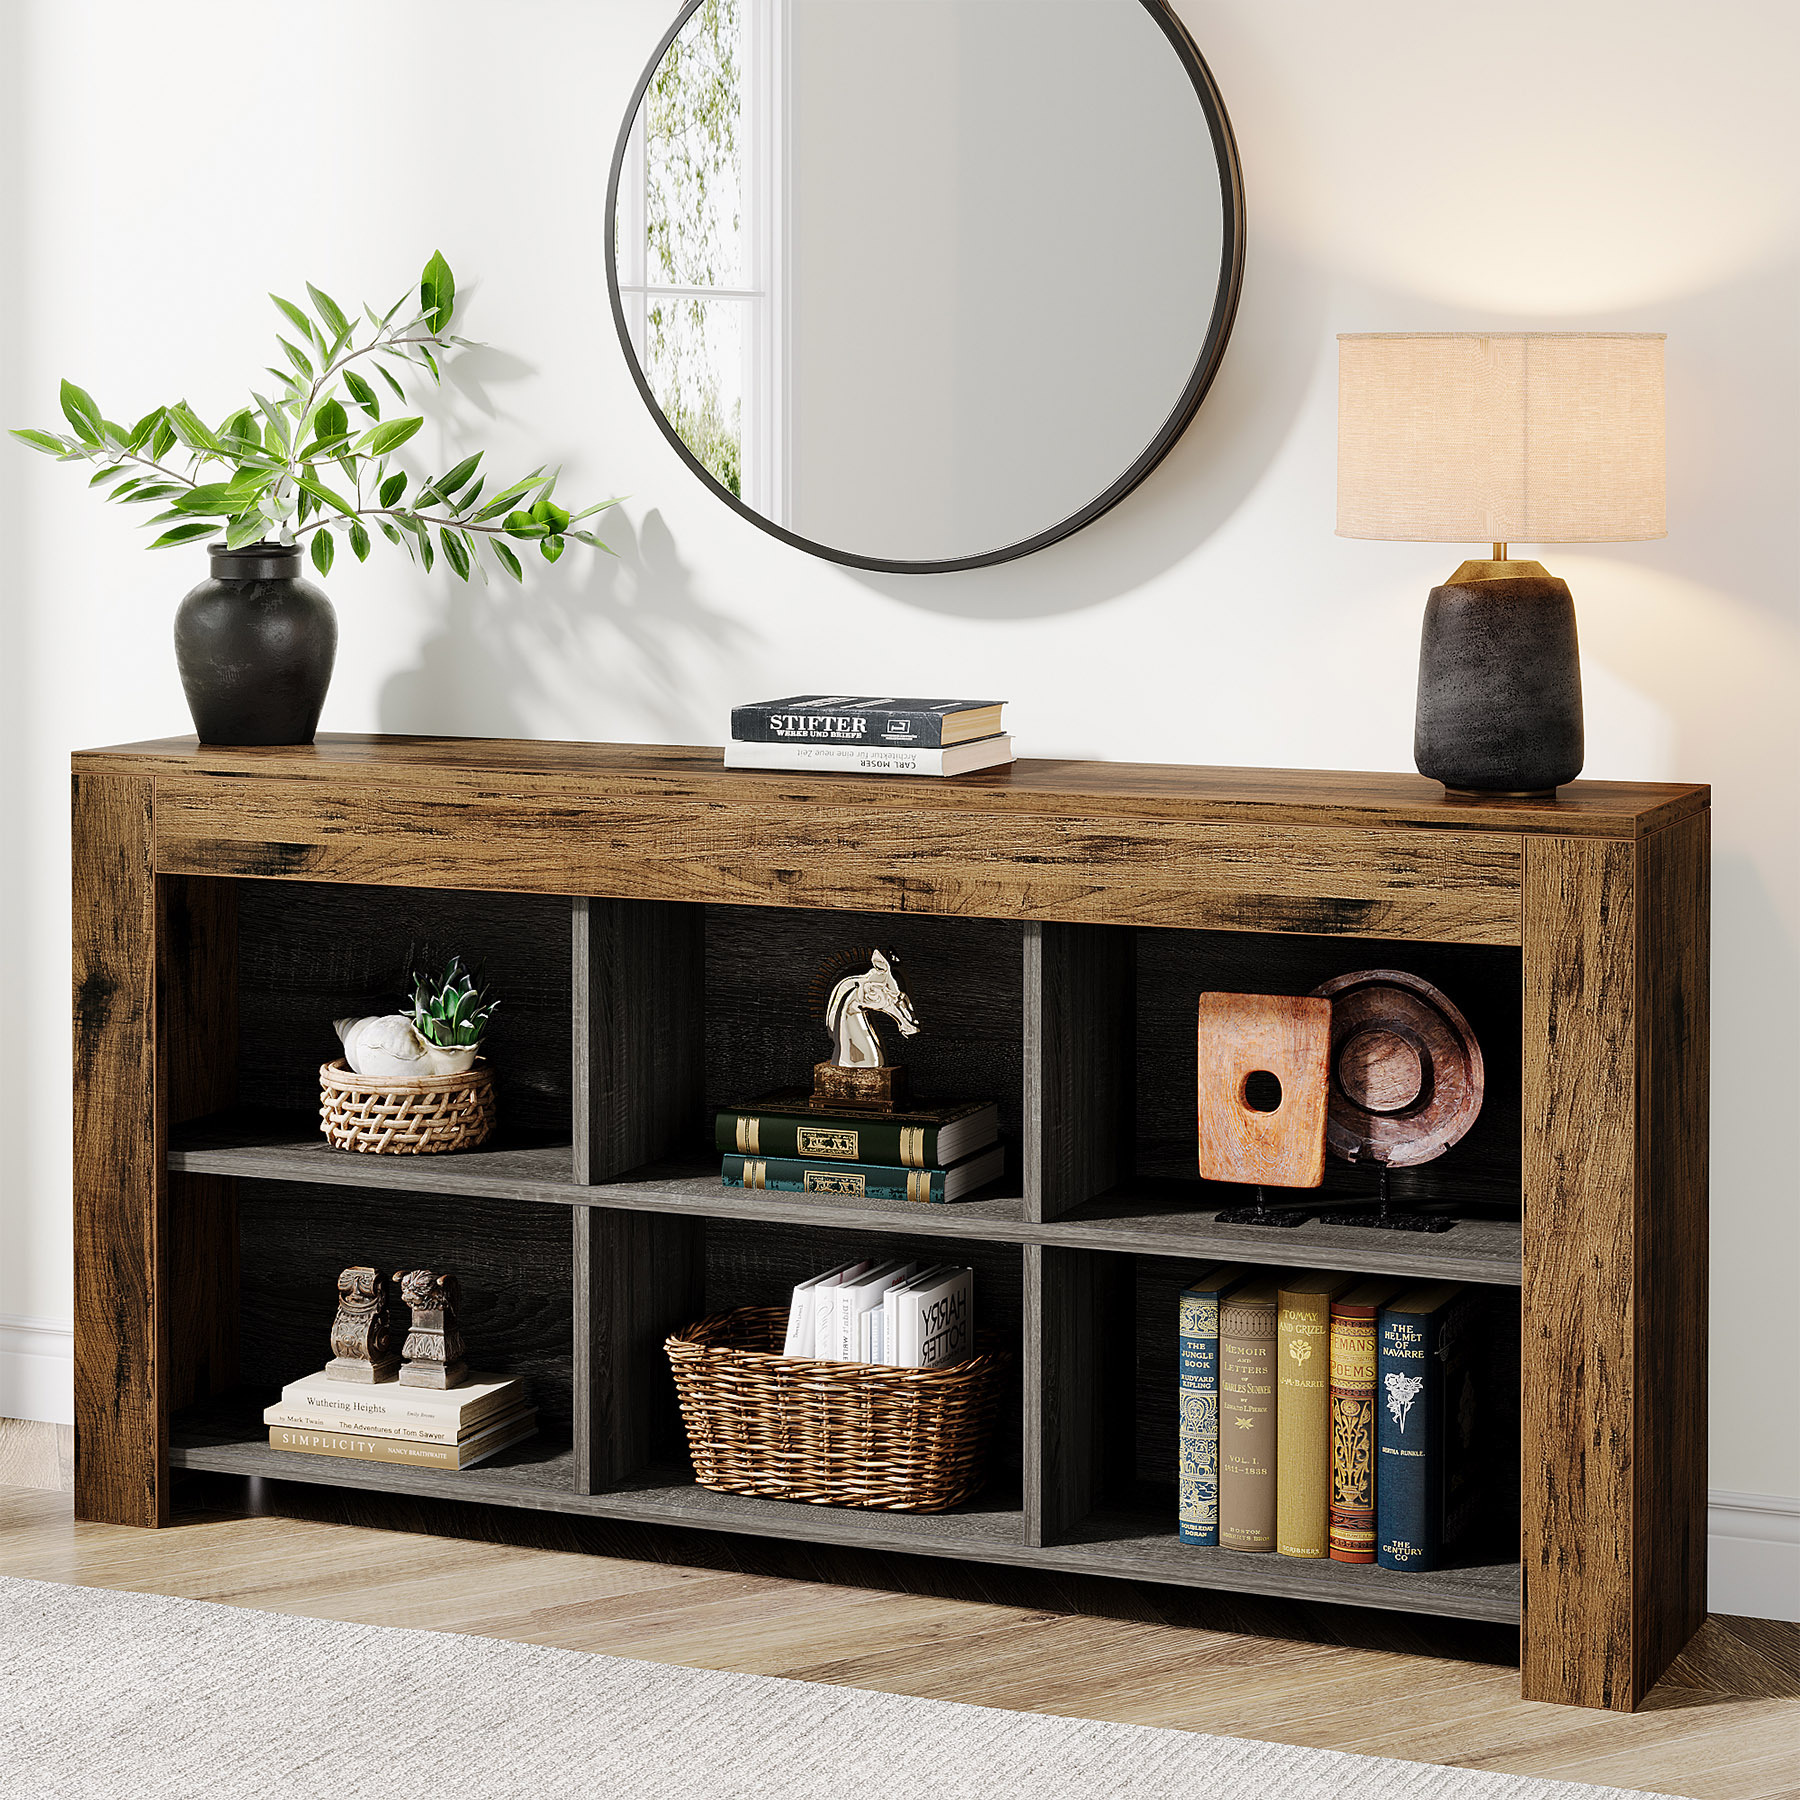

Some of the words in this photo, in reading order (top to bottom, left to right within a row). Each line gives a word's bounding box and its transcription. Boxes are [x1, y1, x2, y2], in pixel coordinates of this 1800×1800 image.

[770, 714, 868, 733] STIFTER
[797, 749, 813, 757] Zeit
[856, 751, 869, 759] für
[871, 752, 917, 761] Architektur
[860, 760, 890, 768] MOSER
[895, 760, 916, 769] CARL
[1282, 1309, 1318, 1321] TOMMY
[1279, 1322, 1293, 1332] AND
[1295, 1324, 1326, 1336] GRIZEL
[1391, 1323, 1413, 1333] THE
[1384, 1331, 1422, 1342] HELMET
[1187, 1341, 1206, 1350] THE
[1225, 1343, 1266, 1356] MEMOIR
[1395, 1341, 1409, 1350] OF
[1181, 1350, 1214, 1359] JUNGLE
[1383, 1347, 1425, 1359] NAVARRE
[1185, 1360, 1210, 1369] BOOK
[1224, 1361, 1268, 1374] LETTERS
[1331, 1360, 1374, 1377] POEMS
[1181, 1374, 1214, 1383] RUDYARD
[1182, 1381, 1211, 1389] KIPLING
[307, 1397, 351, 1411] Wuthering
[353, 1402, 386, 1414] Heights
[339, 1421, 352, 1429] The
[353, 1424, 392, 1434] Adventures
[419, 1431, 445, 1439] Sawyer
[282, 1433, 377, 1453] SIMPLICITY
[388, 1447, 408, 1456] NANCY
[409, 1449, 447, 1460] BRAITHWAITE
[1229, 1455, 1250, 1464] VOL.
[1181, 1522, 1214, 1532] DOUBLEDAY
[1230, 1527, 1261, 1535] BOSTON
[1392, 1540, 1410, 1548] THE
[1383, 1545, 1423, 1555] CENTURY
